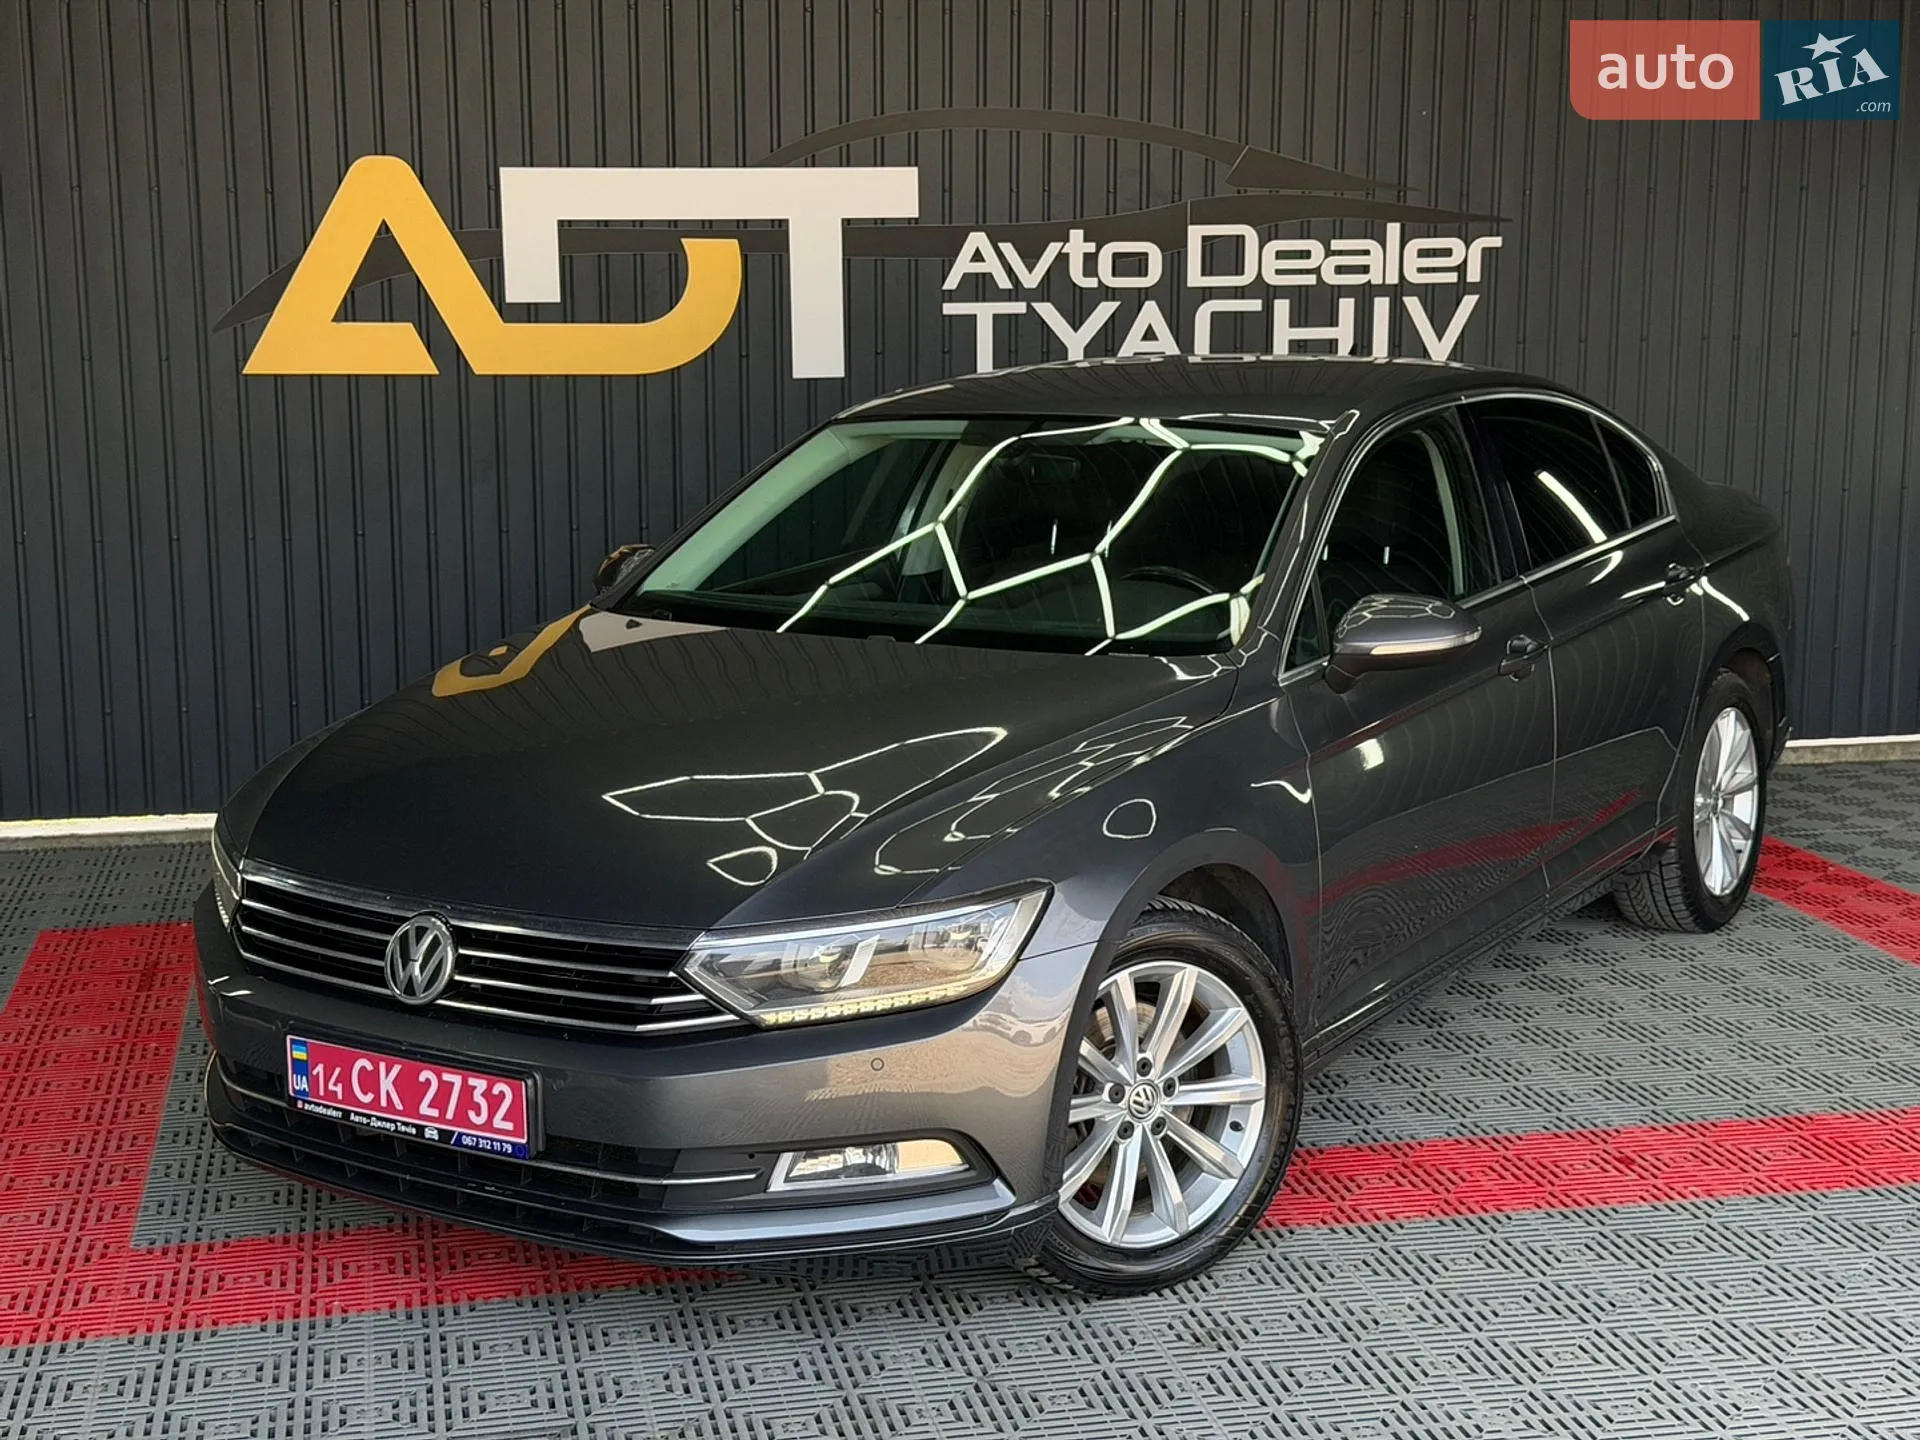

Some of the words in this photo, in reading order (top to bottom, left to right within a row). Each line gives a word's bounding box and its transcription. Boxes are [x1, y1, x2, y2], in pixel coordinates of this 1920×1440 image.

[242, 155, 919, 379] ADT
[942, 229, 1163, 290] Avto
[1187, 222, 1503, 288] Dealer
[942, 294, 1480, 373] TYACHIV
[293, 1074, 309, 1092] UA
[312, 1063, 343, 1100] 14
[418, 1069, 514, 1131] 2732
[461, 1135, 476, 1146] 067
[478, 1138, 491, 1149] 312
[493, 1141, 501, 1152] 11
[502, 1142, 512, 1153] 79
